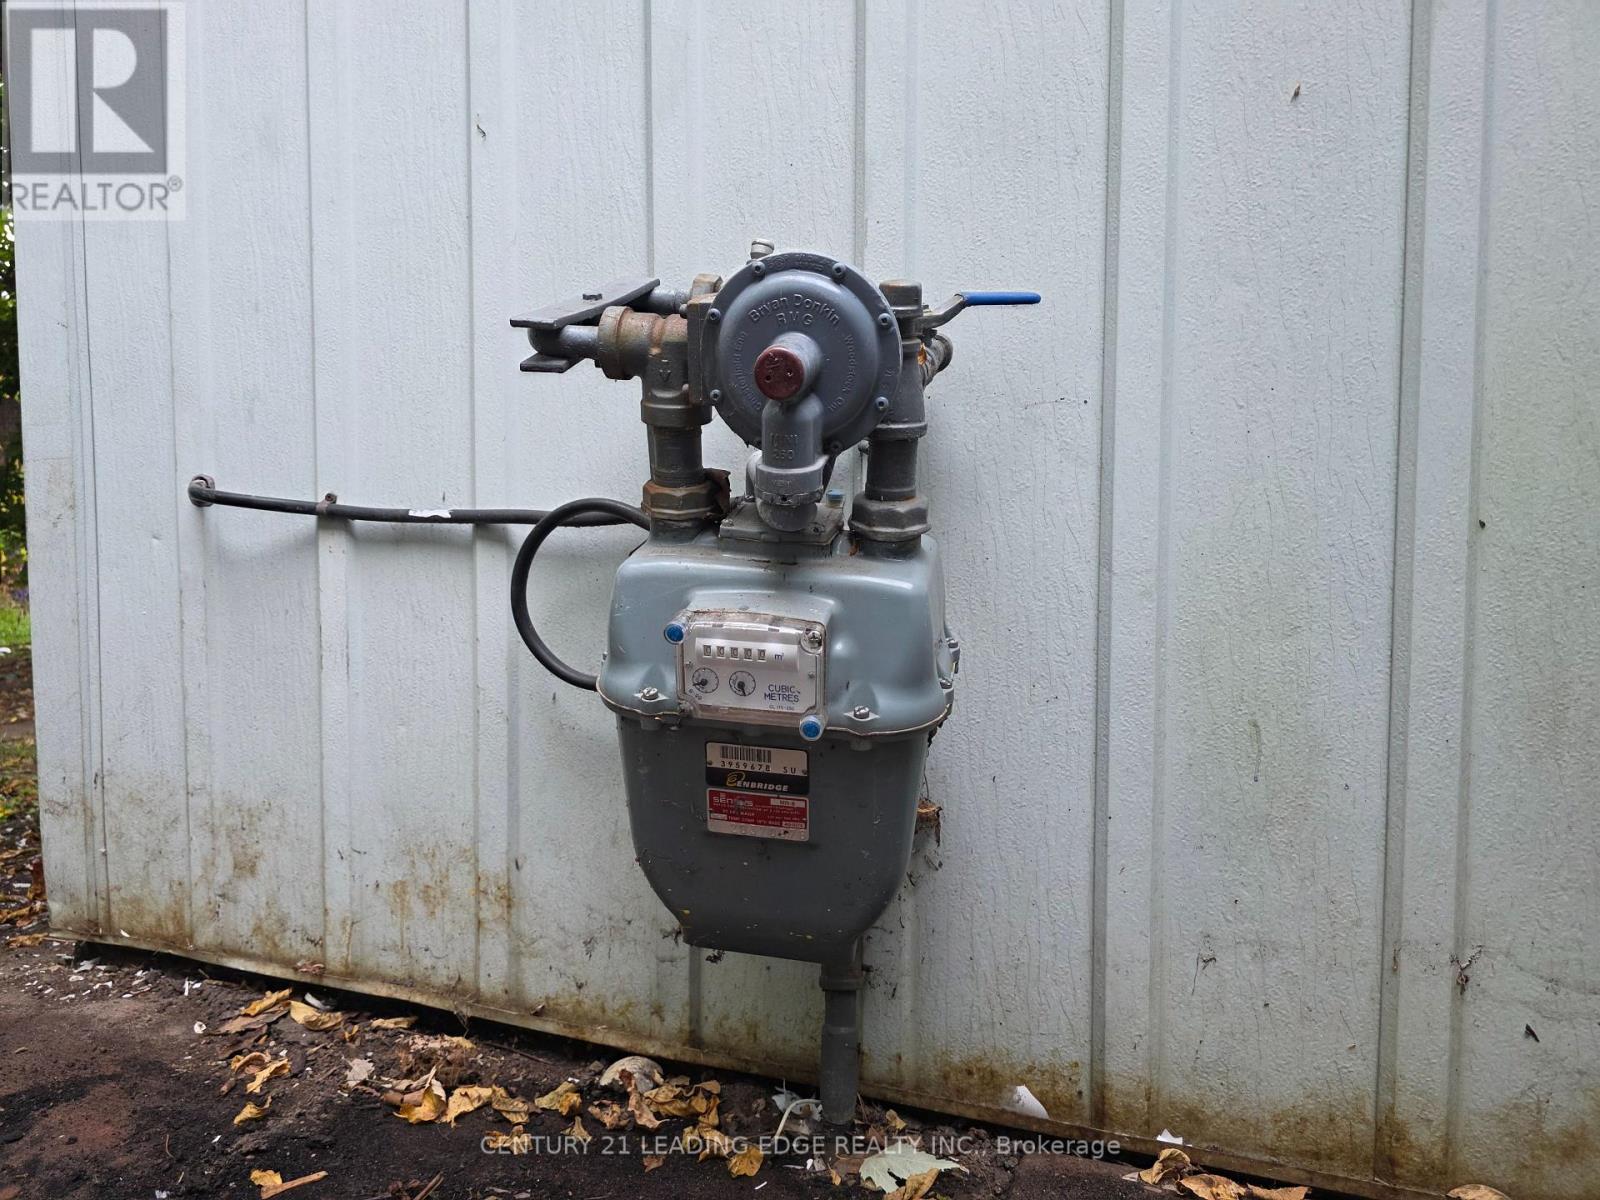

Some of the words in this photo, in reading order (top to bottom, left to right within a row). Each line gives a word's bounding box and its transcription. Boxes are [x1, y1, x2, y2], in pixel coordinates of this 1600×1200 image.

[748, 297, 789, 323] Bryan
[793, 293, 841, 327] Donkin
[768, 683, 796, 694] CUBIC
[763, 692, 800, 703] METRES
[737, 781, 790, 792] ENBRIDGE
